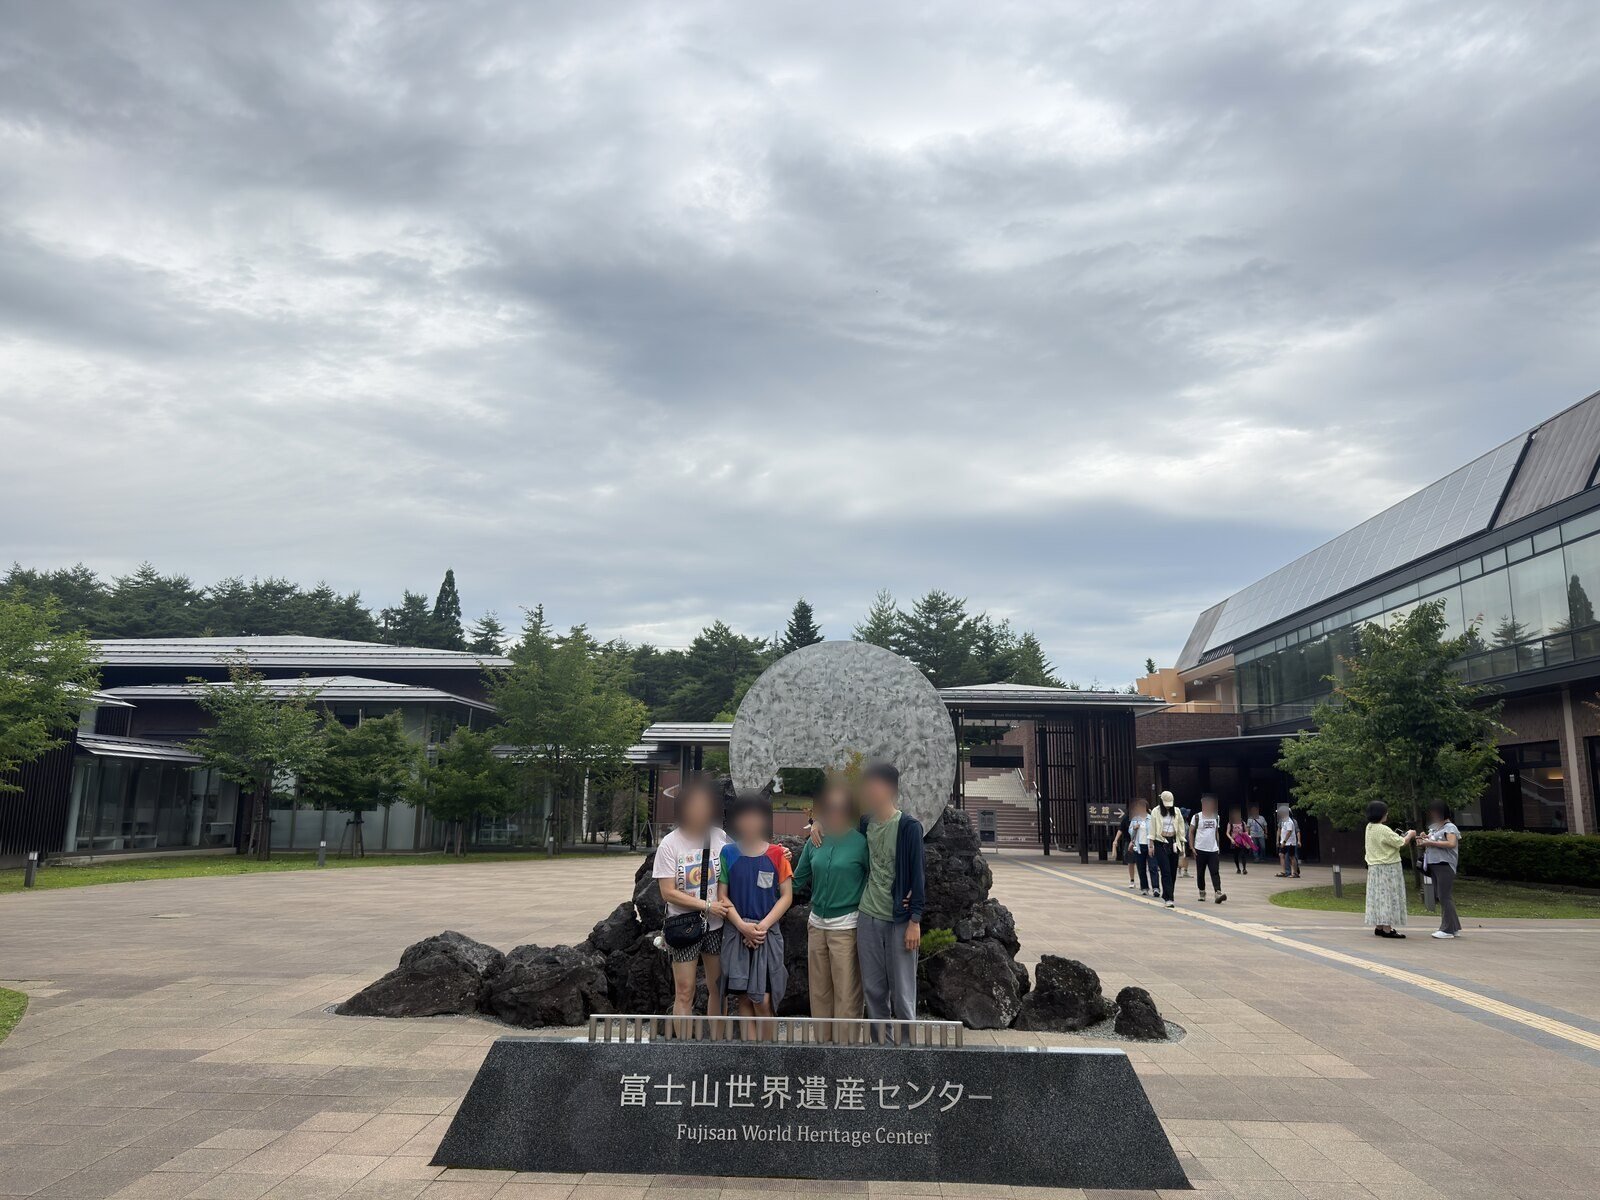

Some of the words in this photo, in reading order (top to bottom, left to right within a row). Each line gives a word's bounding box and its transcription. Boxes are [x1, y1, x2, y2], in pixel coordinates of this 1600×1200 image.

[619, 1073, 993, 1112] 富士山世界遺産センター
[676, 1123, 737, 1144] Fujisan
[742, 1125, 792, 1142] World
[797, 1125, 871, 1147] Heritage
[875, 1127, 932, 1145] Center
